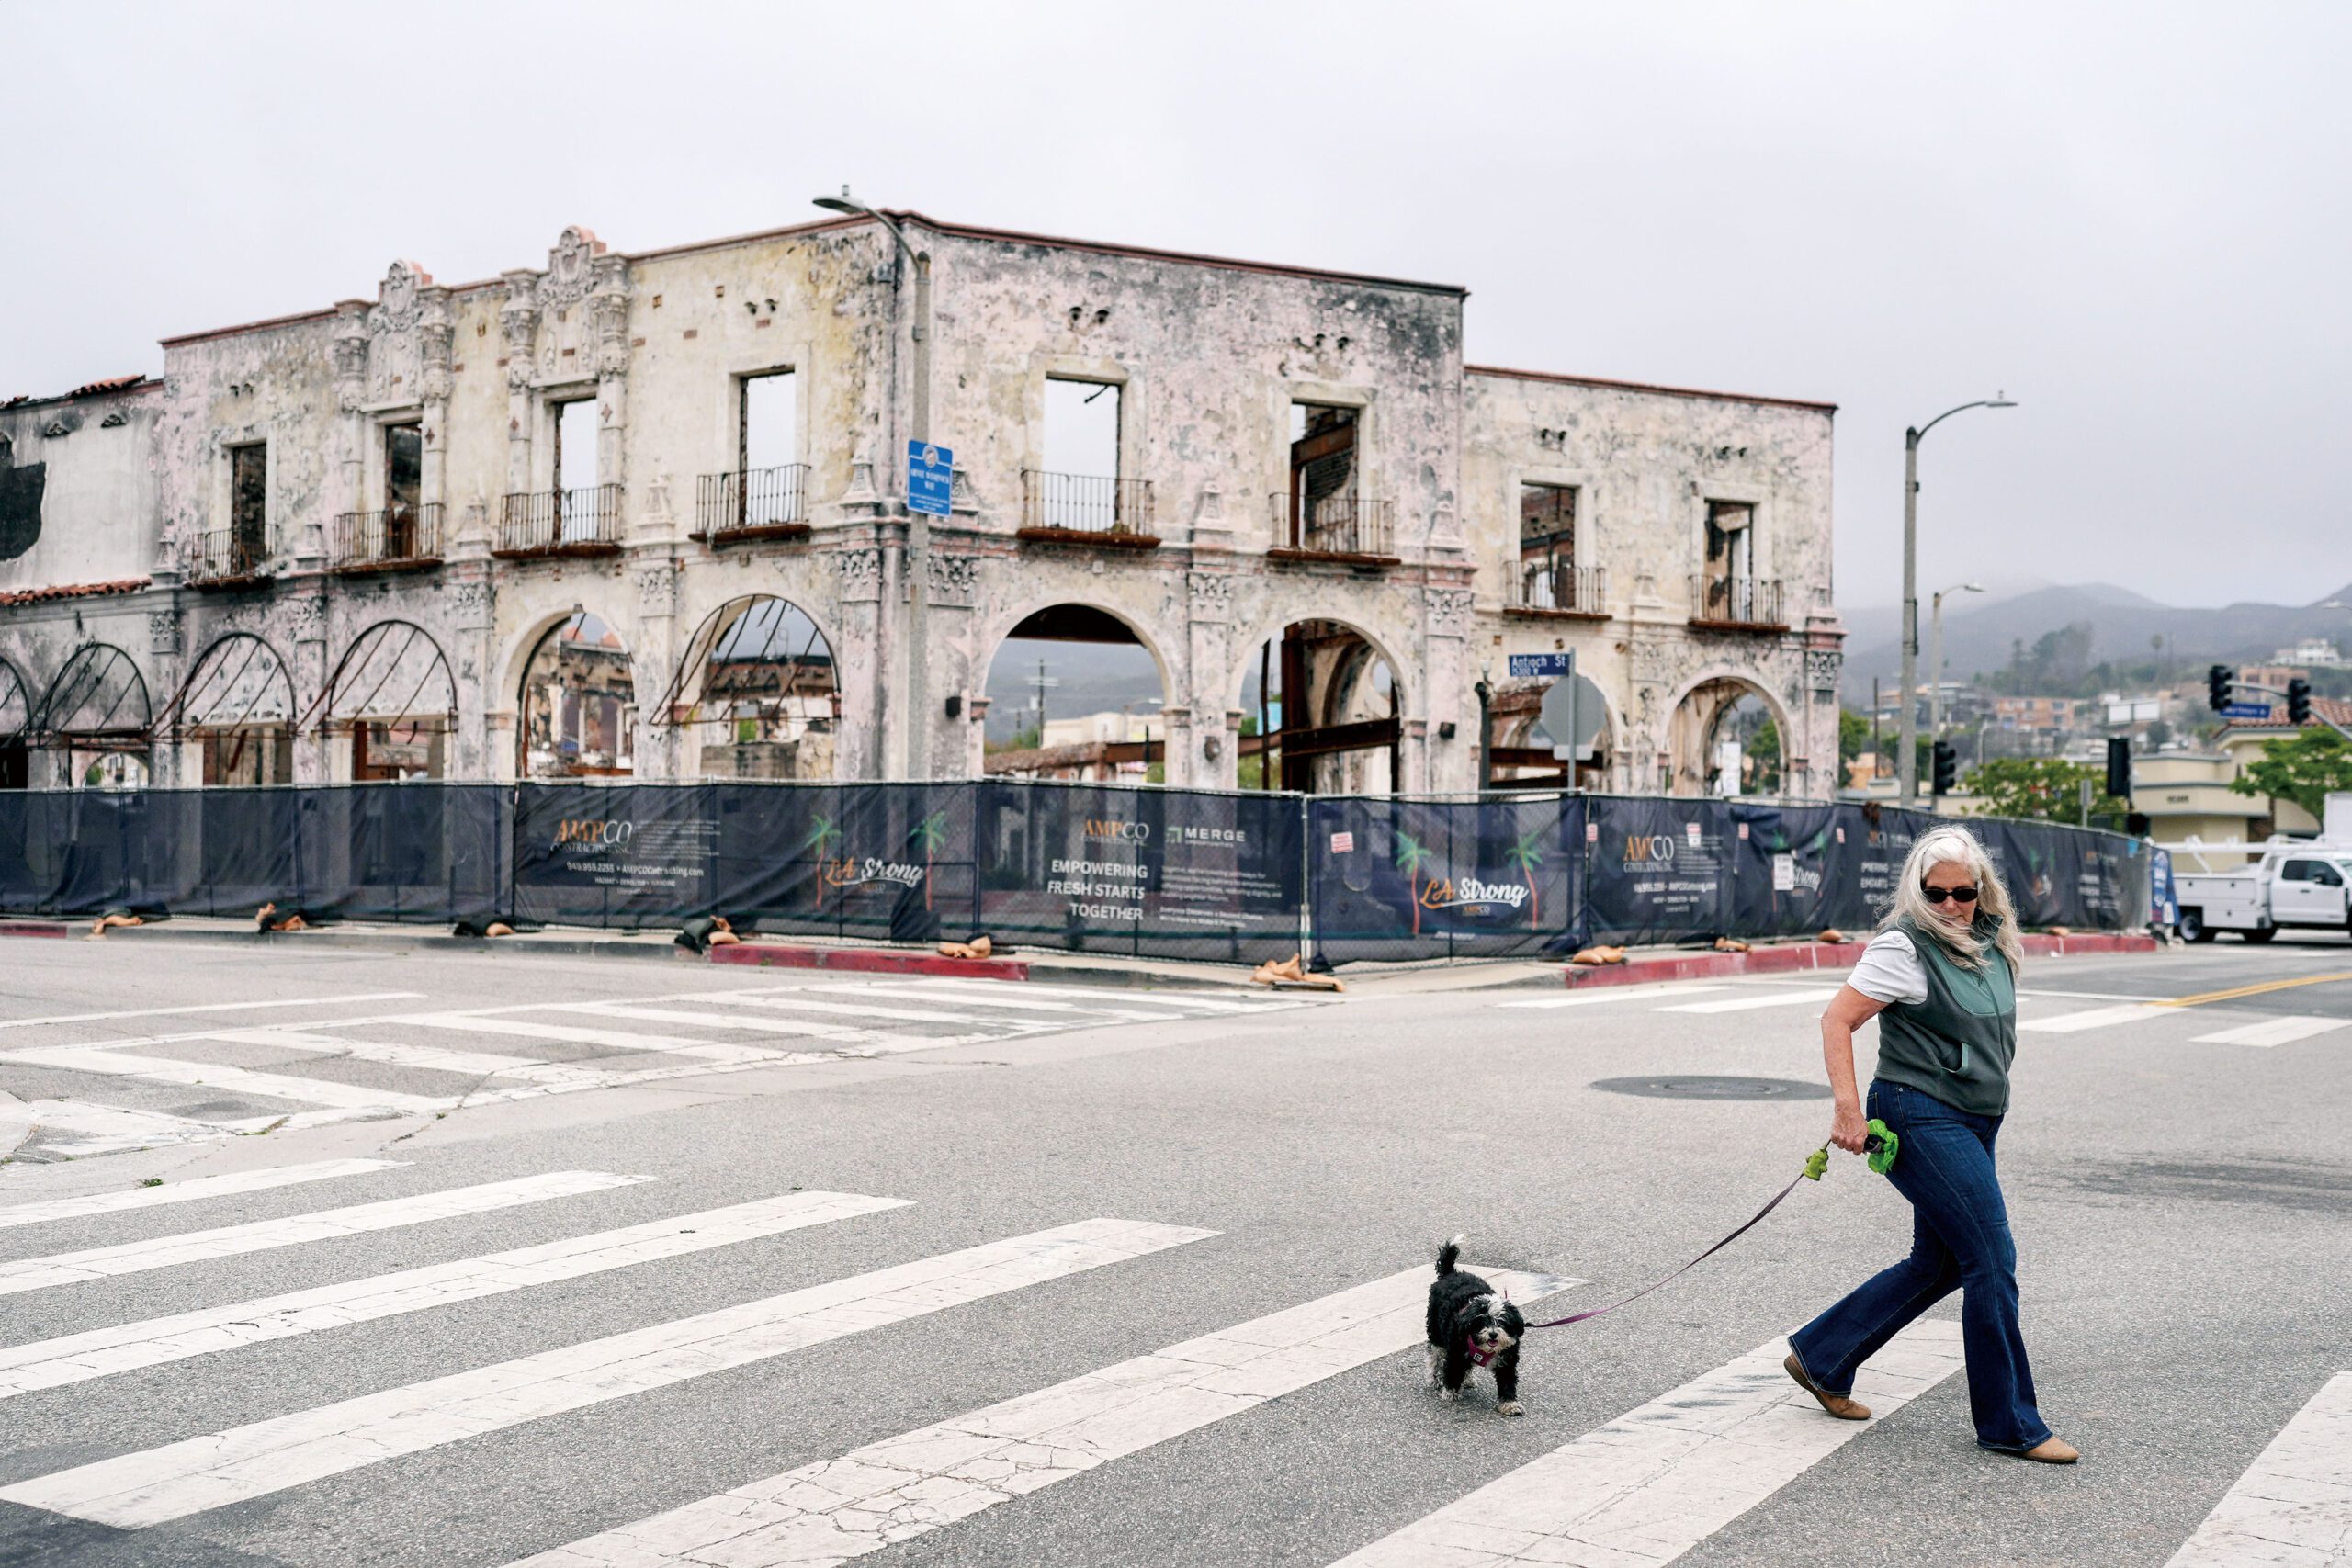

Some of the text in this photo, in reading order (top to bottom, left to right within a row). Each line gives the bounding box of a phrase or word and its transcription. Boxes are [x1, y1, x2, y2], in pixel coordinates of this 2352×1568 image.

[1512, 655, 1566, 669] Antioch St
[1082, 819, 1149, 840] AMPCO
[1184, 827, 1246, 842] MERGE
[1051, 859, 1148, 880] EMPOWERING
[1047, 880, 1092, 897] FRESH
[1094, 883, 1146, 900] STARTS
[1419, 877, 1530, 909] LA Strong
[1069, 902, 1144, 921] TOGETHER
